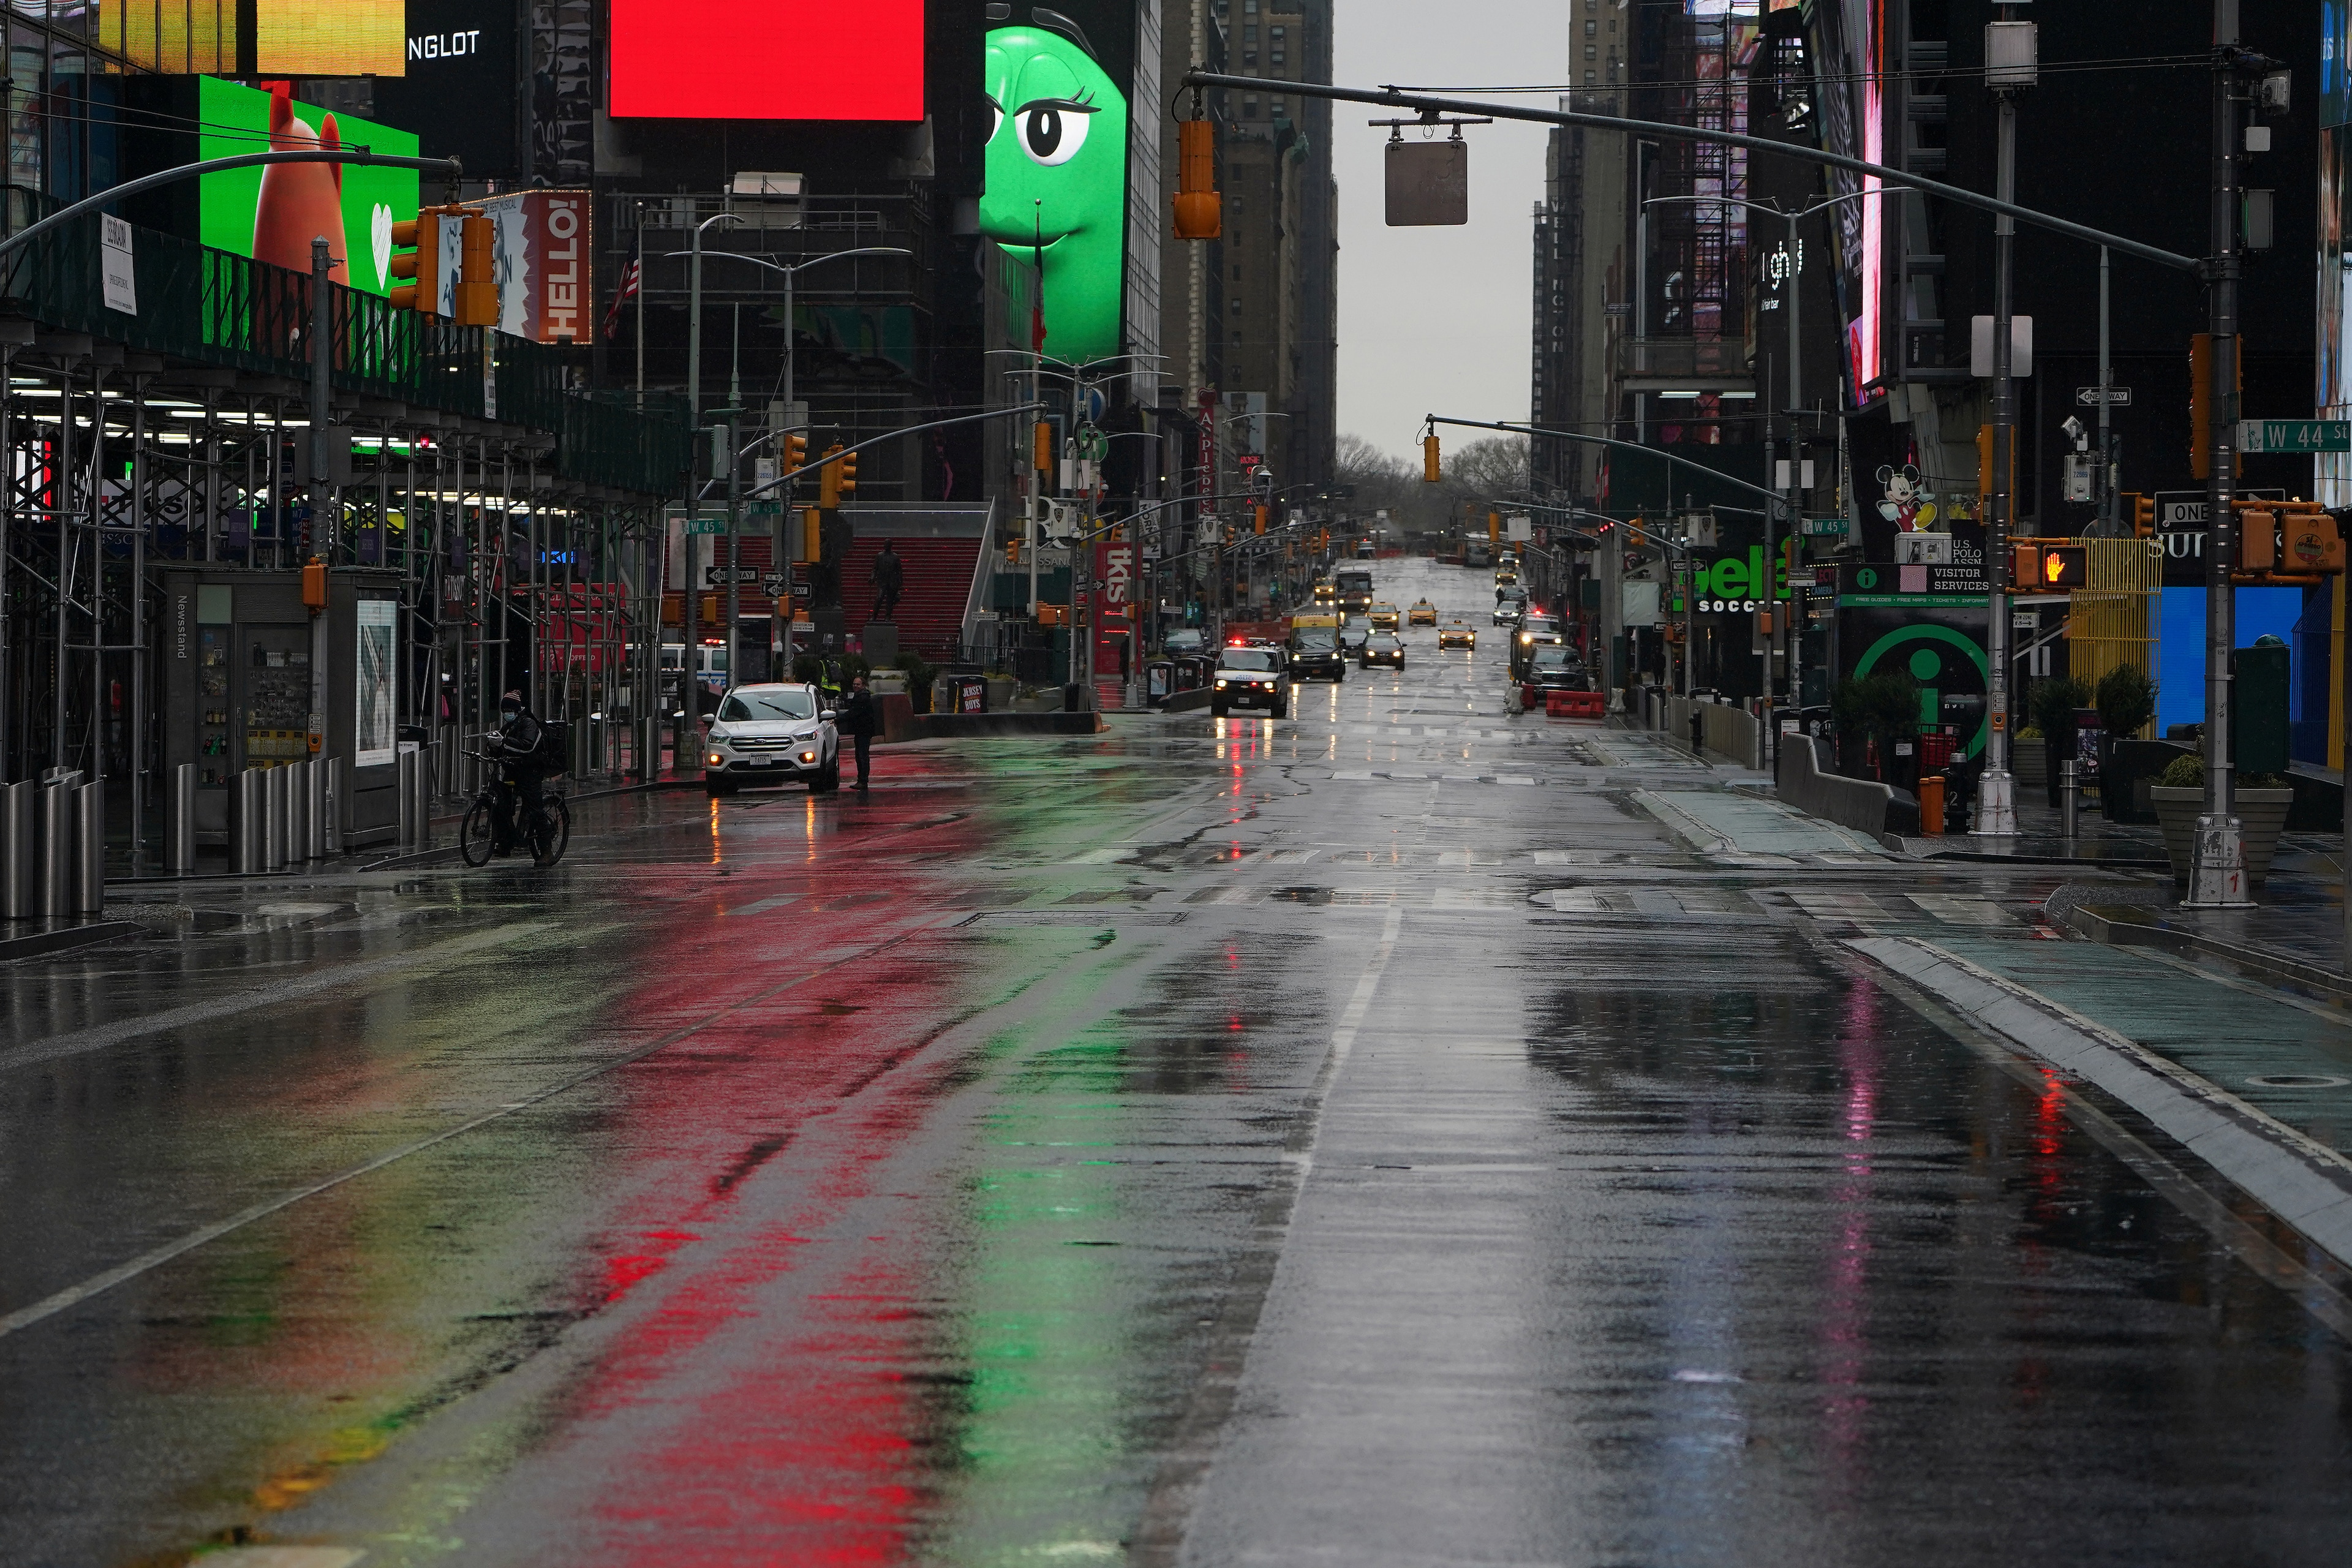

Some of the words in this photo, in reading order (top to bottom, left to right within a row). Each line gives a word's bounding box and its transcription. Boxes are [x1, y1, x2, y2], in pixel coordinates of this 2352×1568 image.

[409, 31, 480, 60] NGLOT
[490, 202, 499, 213] BEST
[500, 199, 516, 211] MUSICAL
[548, 199, 578, 336] HELLO!
[2268, 425, 2286, 448] W
[2297, 424, 2323, 448] 44
[2334, 424, 2347, 439] St
[292, 509, 303, 518] M7
[752, 504, 760, 513] W
[763, 503, 772, 513] 45
[2175, 505, 2208, 521] ONE
[691, 522, 699, 532] W
[704, 522, 715, 532] 45
[1815, 521, 1823, 532] W
[1827, 521, 1838, 532] 45
[1953, 540, 1972, 549] U.S.
[1953, 549, 1981, 558] POLO
[1107, 547, 1132, 603] tkts
[1934, 568, 1981, 578] VISITOR
[1934, 581, 1989, 590] SERVICES
[1698, 600, 1783, 612] SOCC
[178, 595, 187, 659] Newsstand
[963, 685, 982, 698] JERSEY
[965, 698, 981, 710] BOYS
